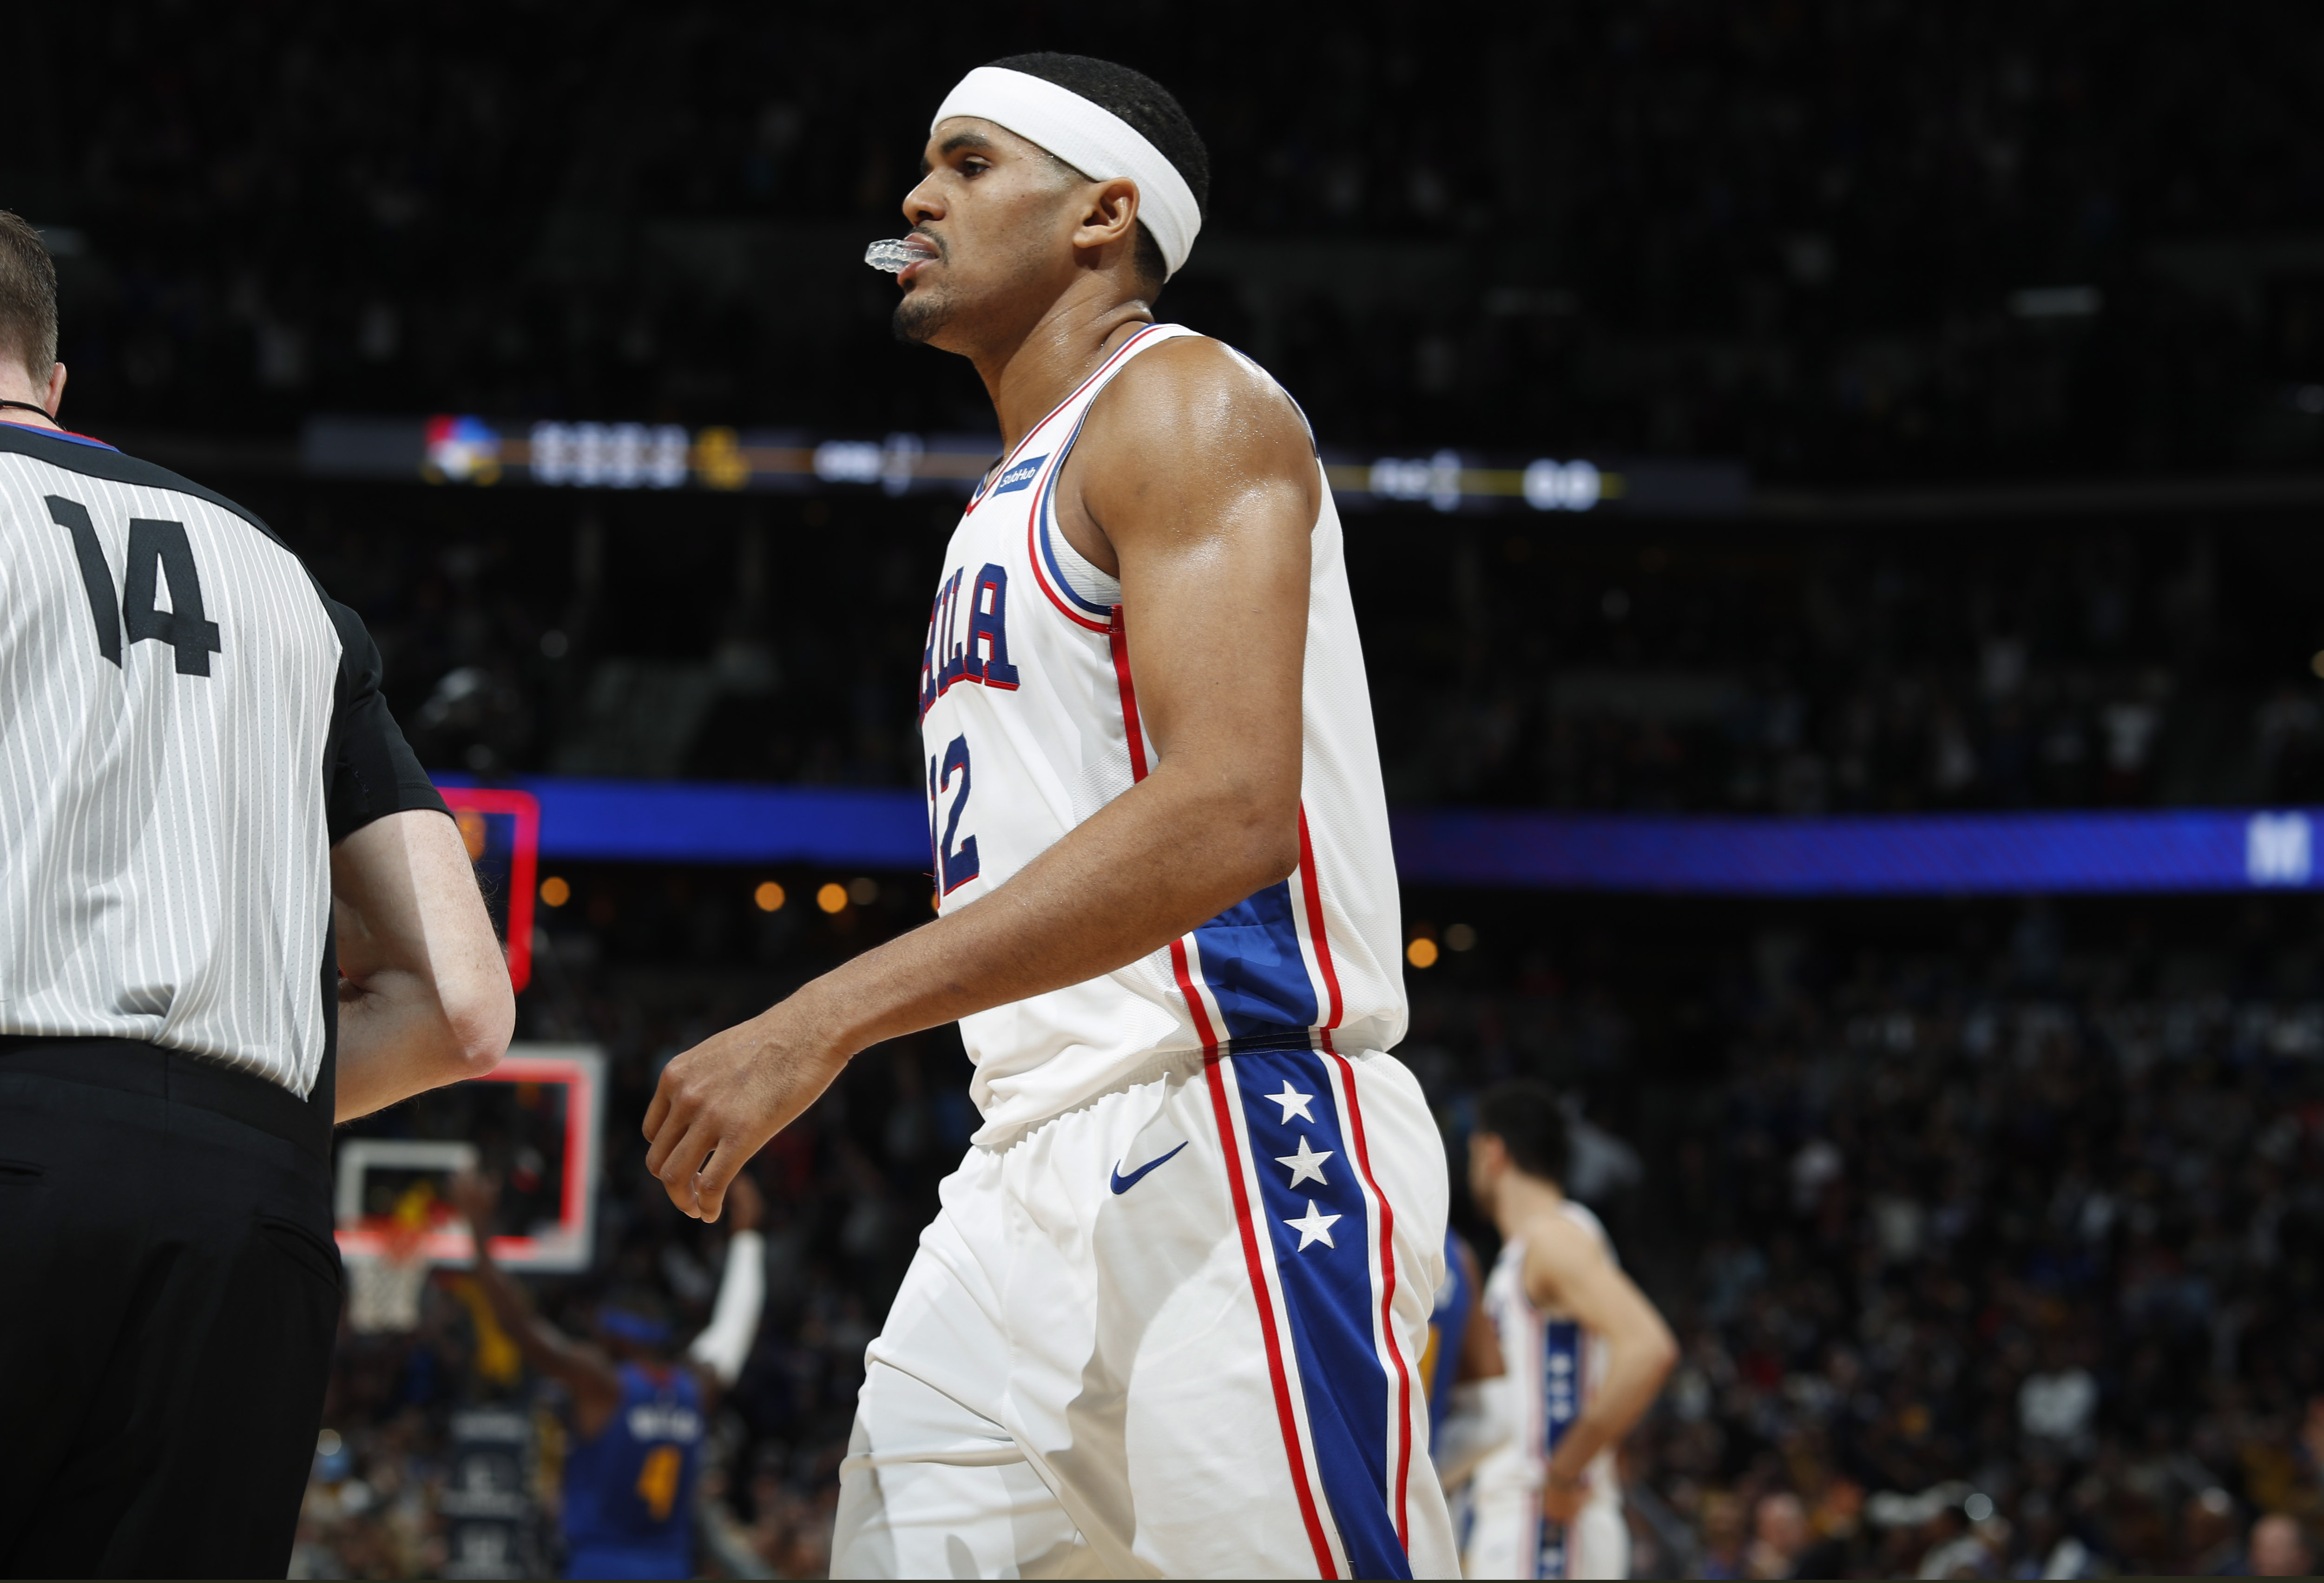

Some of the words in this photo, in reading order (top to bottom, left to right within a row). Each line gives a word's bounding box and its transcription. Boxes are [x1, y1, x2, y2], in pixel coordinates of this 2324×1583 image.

[1000, 466, 1036, 488] StubHub
[43, 494, 221, 678] 14
[919, 562, 1020, 728] HILA
